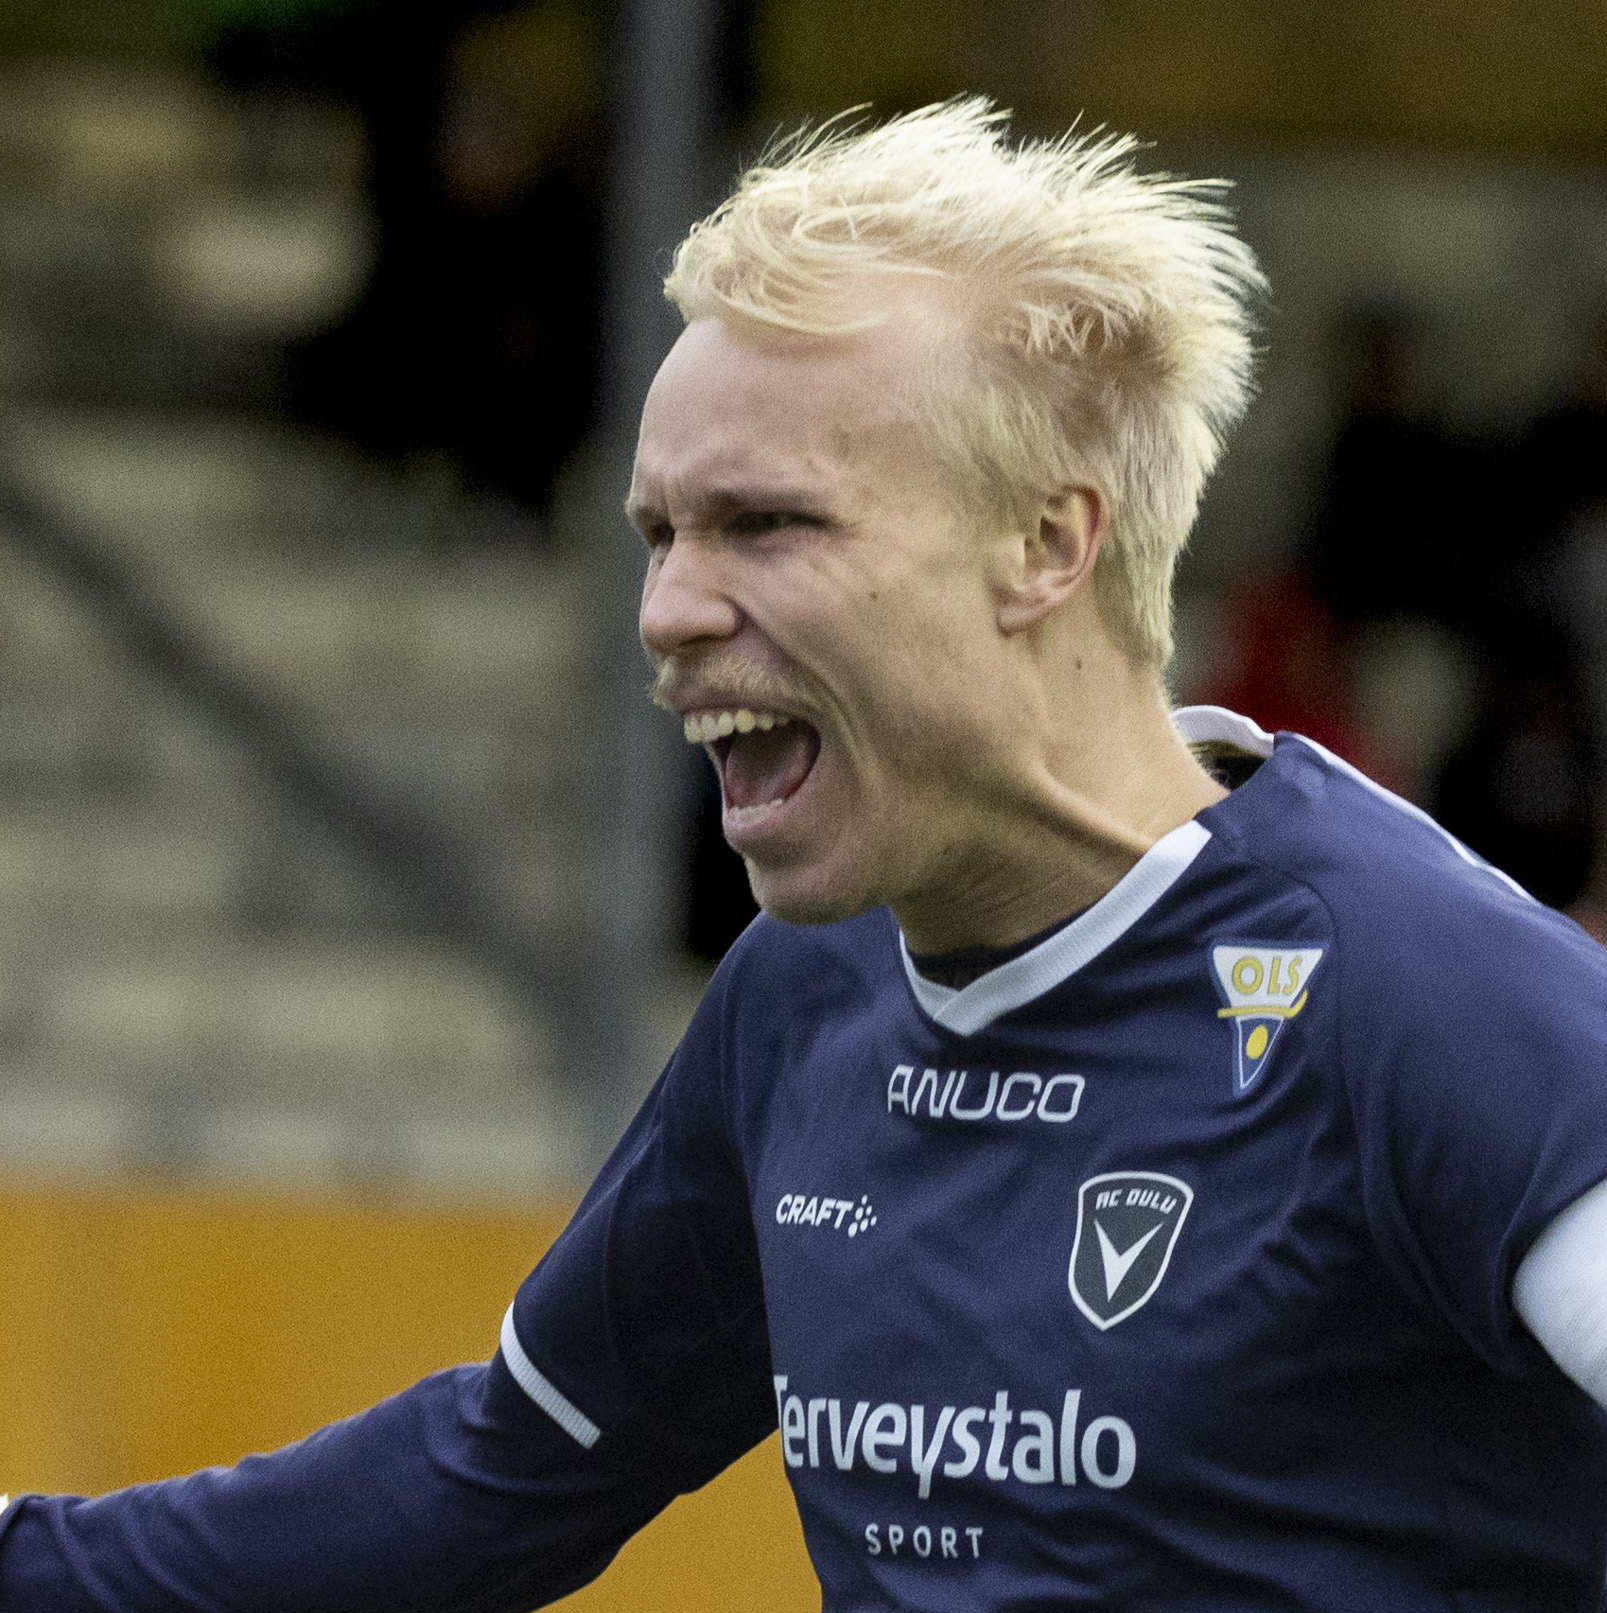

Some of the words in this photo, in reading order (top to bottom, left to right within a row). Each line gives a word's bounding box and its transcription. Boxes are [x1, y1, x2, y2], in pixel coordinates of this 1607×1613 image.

[1231, 955, 1303, 990] OLS
[887, 1063, 1086, 1123] ANUCO
[776, 1193, 855, 1230] CRAFT
[1094, 1188, 1123, 1211] AC
[1125, 1187, 1178, 1215] OULU
[864, 1522, 985, 1560] SPORT
